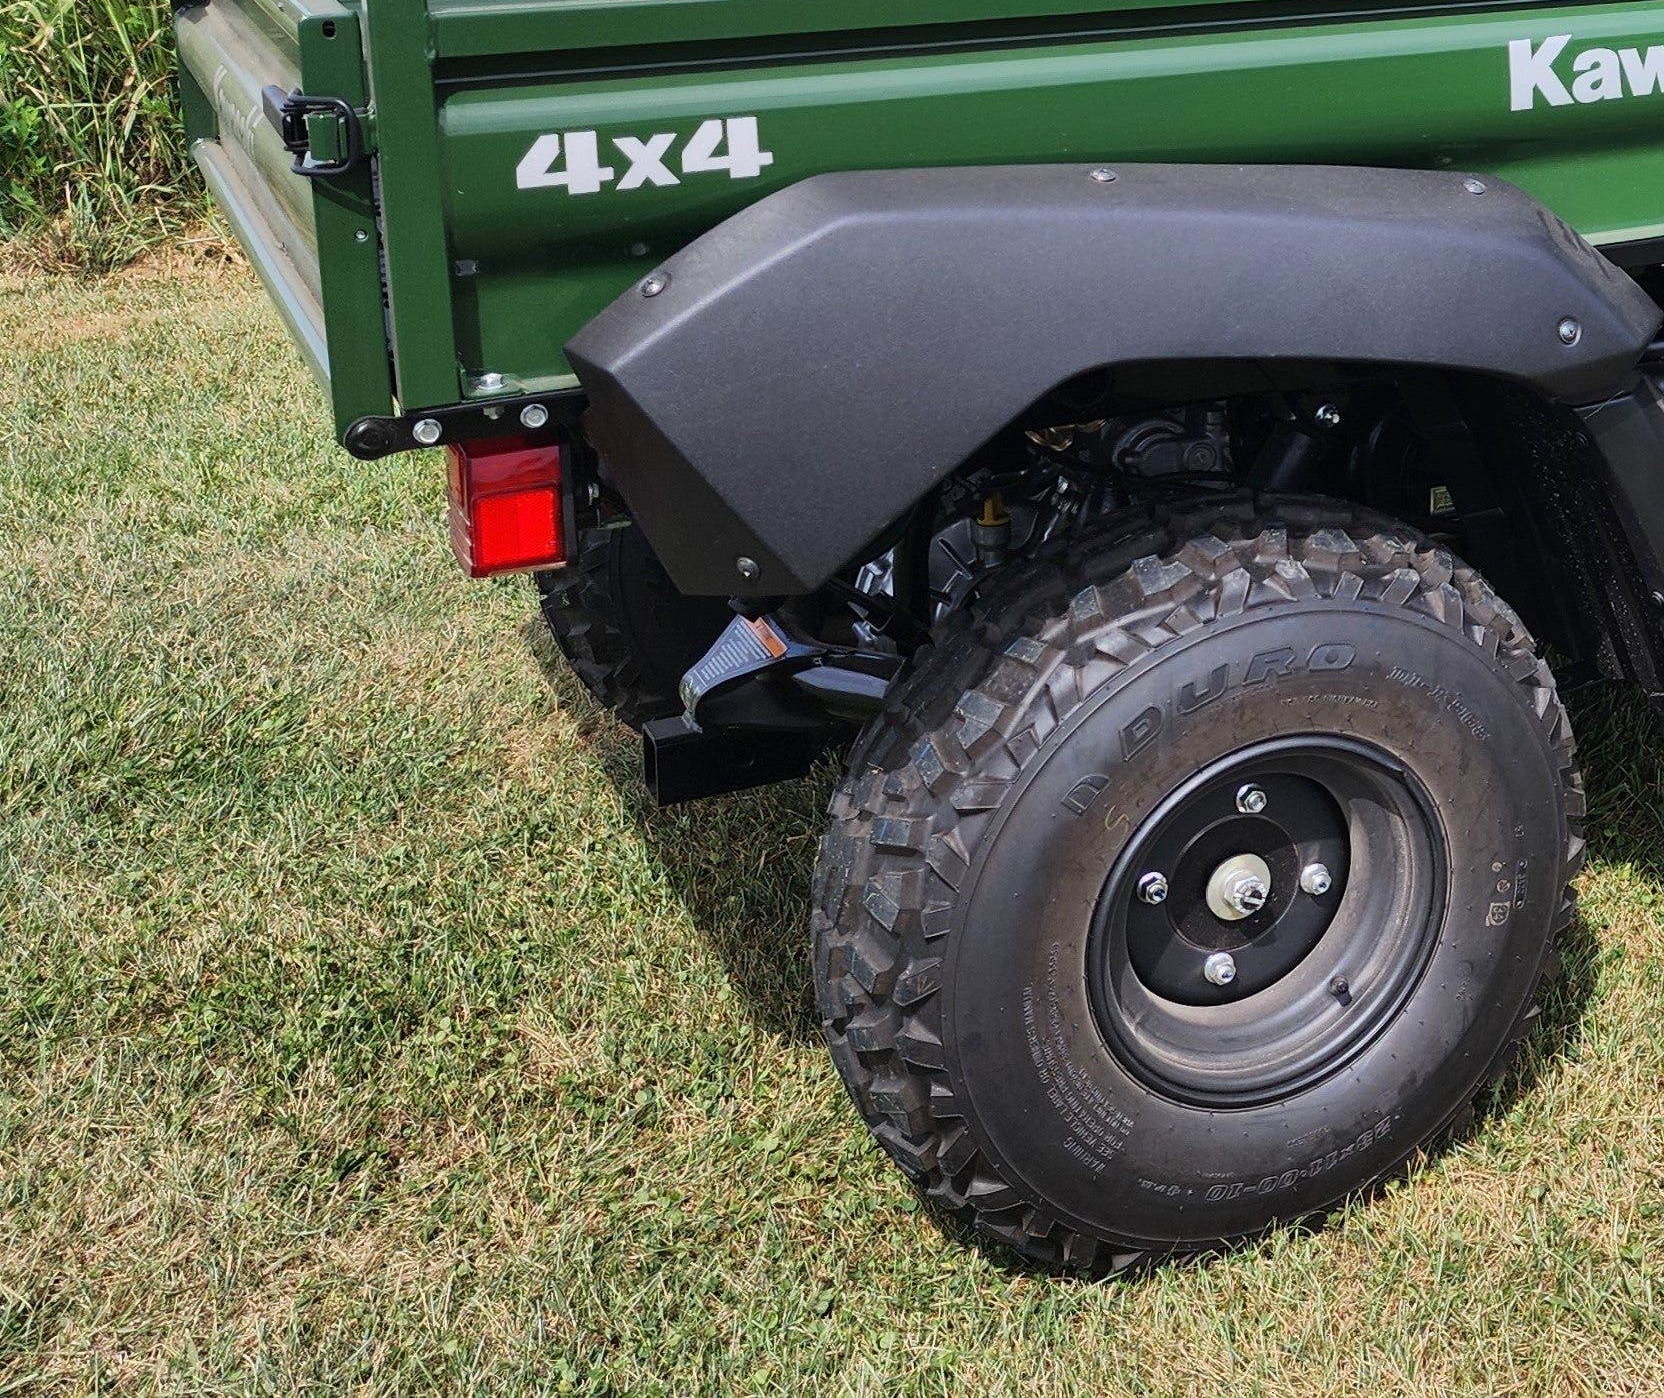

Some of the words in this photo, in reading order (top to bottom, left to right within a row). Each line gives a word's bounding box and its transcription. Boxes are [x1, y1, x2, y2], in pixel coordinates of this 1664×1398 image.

[514, 115, 775, 196] 4x4
[1120, 641, 1357, 762] DURO
[1037, 1067, 1051, 1085] OR
[1061, 1111, 1100, 1148] VEHICLE
[1062, 1136, 1108, 1174] WARNING
[1095, 1142, 1117, 1160] SEE
